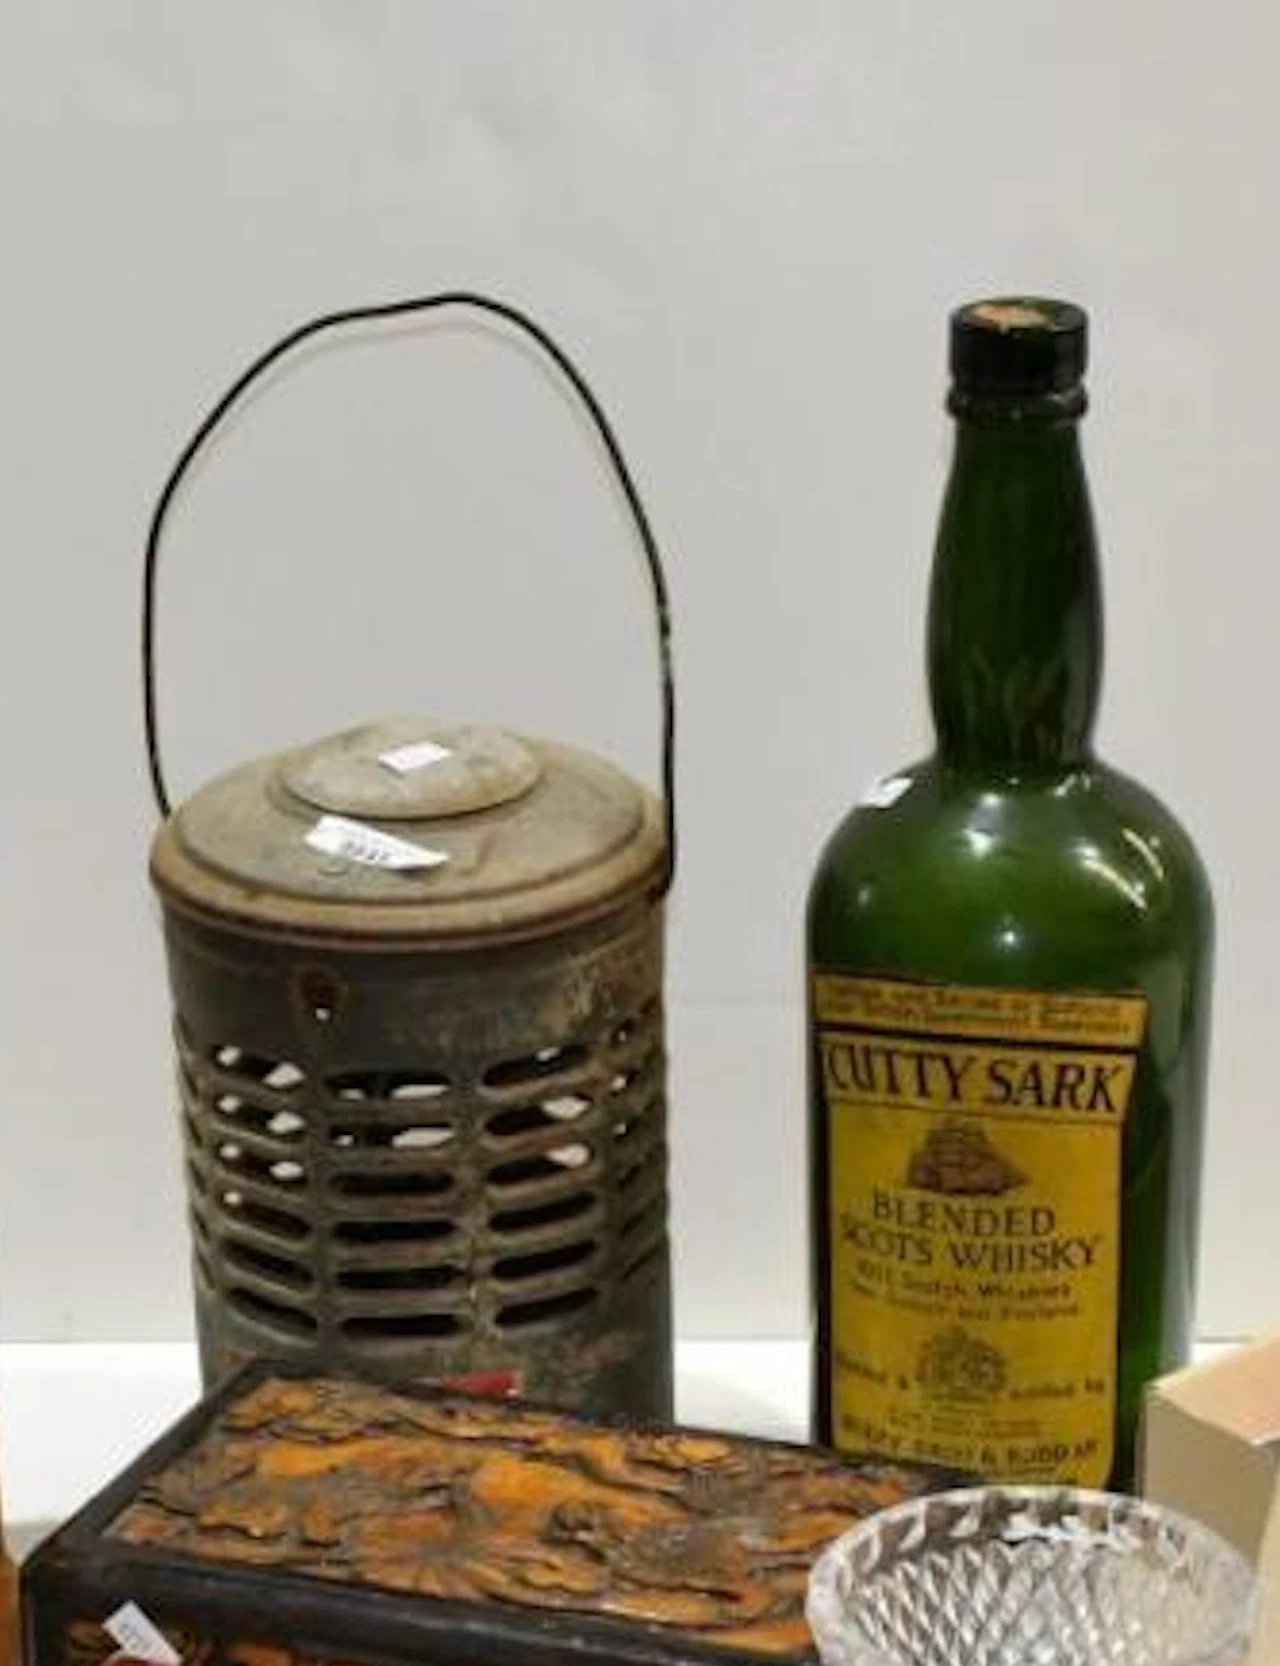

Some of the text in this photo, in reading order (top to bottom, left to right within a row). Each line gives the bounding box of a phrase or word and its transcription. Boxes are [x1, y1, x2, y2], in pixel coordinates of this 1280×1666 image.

[825, 1042, 1124, 1114] CUTTY SARK
[840, 1211, 1105, 1276] SCOTS WHISKY
[872, 1188, 1056, 1239] BLENDED
